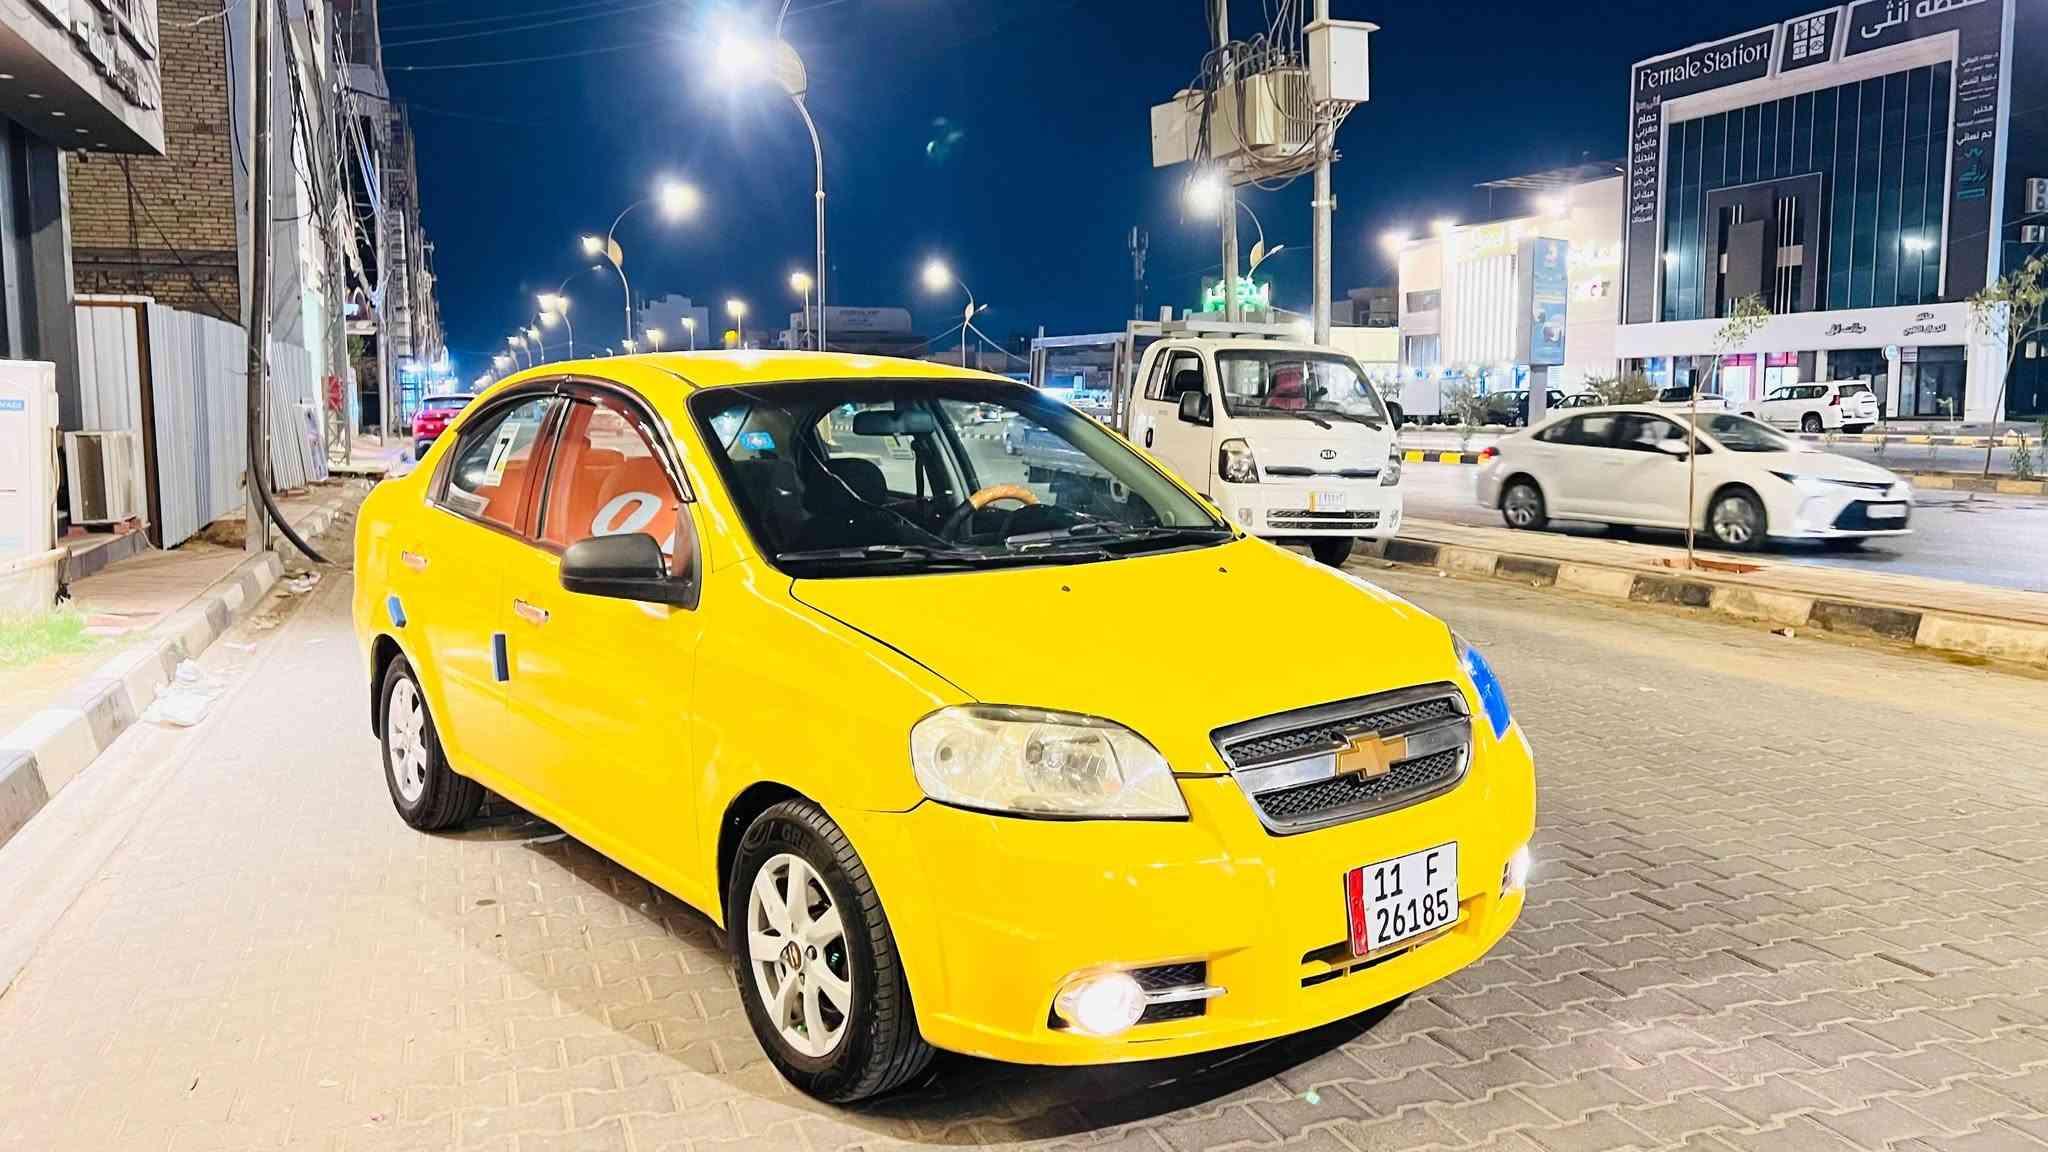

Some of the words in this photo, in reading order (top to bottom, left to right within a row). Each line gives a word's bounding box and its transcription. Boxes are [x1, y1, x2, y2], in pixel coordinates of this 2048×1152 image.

[1640, 56, 1701, 91] Female
[1703, 43, 1768, 74] Station
[1637, 113, 1657, 128] حمام
[493, 438, 510, 472] 7
[1374, 862, 1404, 903] 11
[1426, 851, 1440, 887] F
[1377, 888, 1449, 943] 26185
